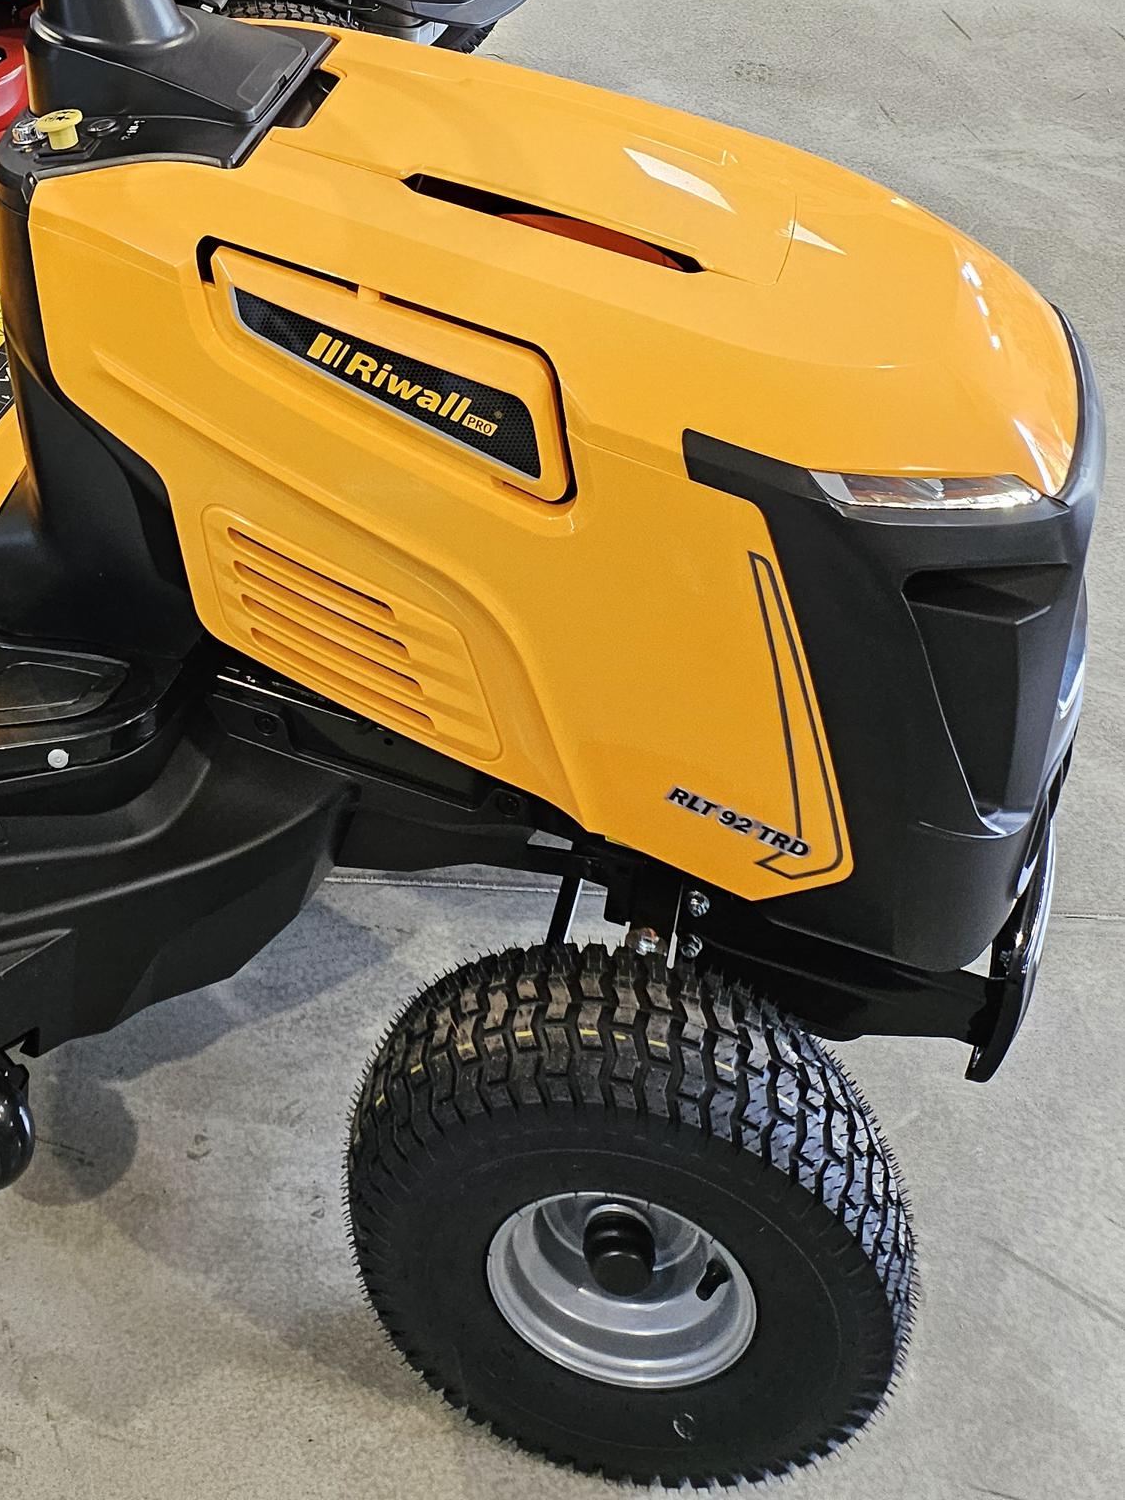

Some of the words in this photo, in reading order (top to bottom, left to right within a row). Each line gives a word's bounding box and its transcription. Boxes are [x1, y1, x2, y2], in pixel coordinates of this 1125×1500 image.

[344, 351, 473, 423] Riwall
[466, 416, 493, 434] PRO
[668, 786, 718, 816] RLT
[718, 810, 753, 835] 92
[758, 825, 810, 857] TRD
